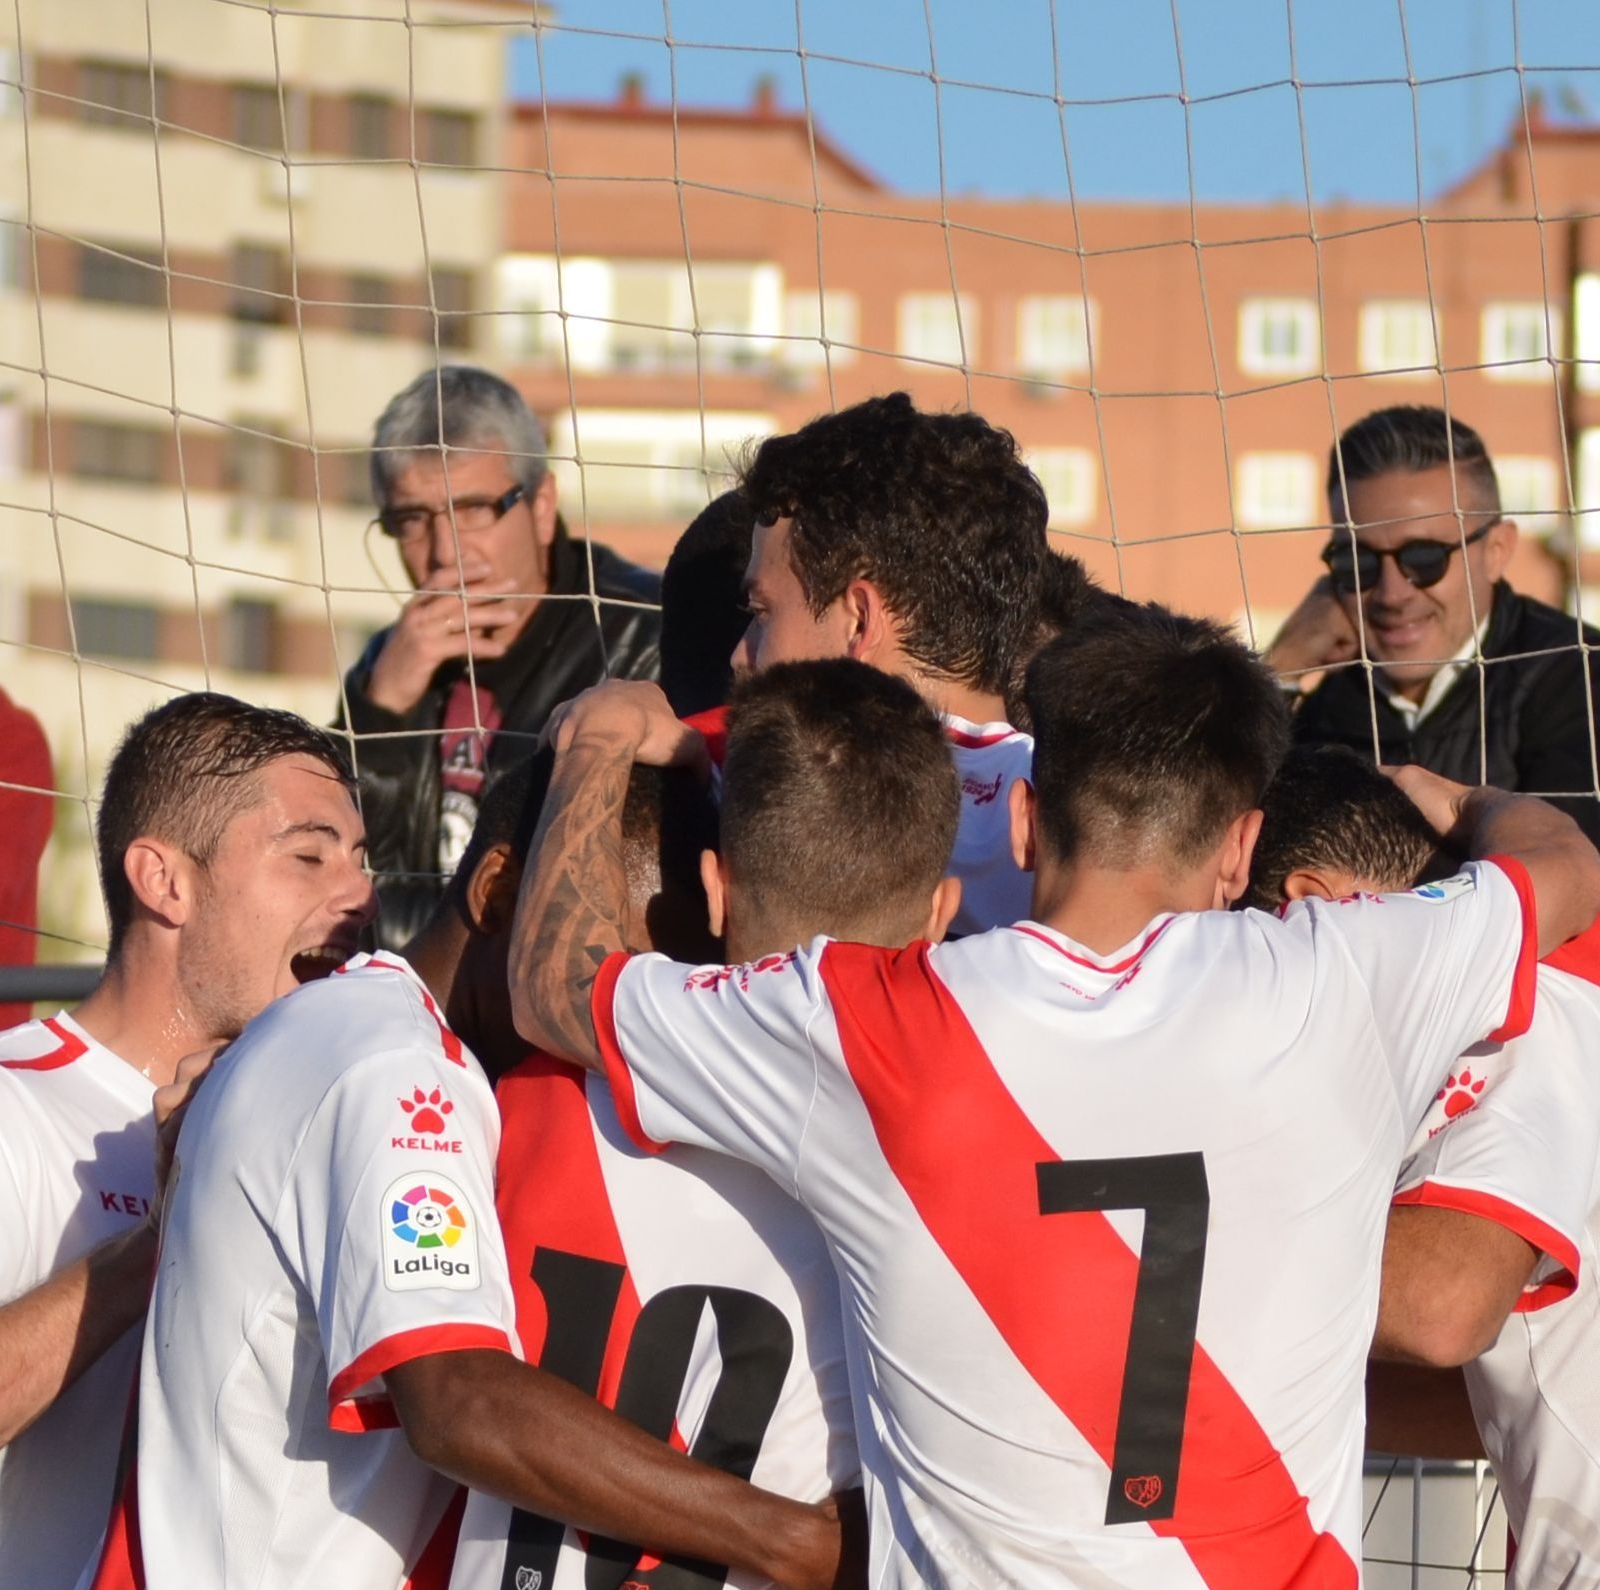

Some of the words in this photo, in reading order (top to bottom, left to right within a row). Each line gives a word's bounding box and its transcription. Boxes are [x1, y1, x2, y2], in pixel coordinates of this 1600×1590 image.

[392, 1137, 463, 1153] KELME
[394, 1254, 470, 1276] LaLiga
[1035, 1151, 1210, 1525] 7
